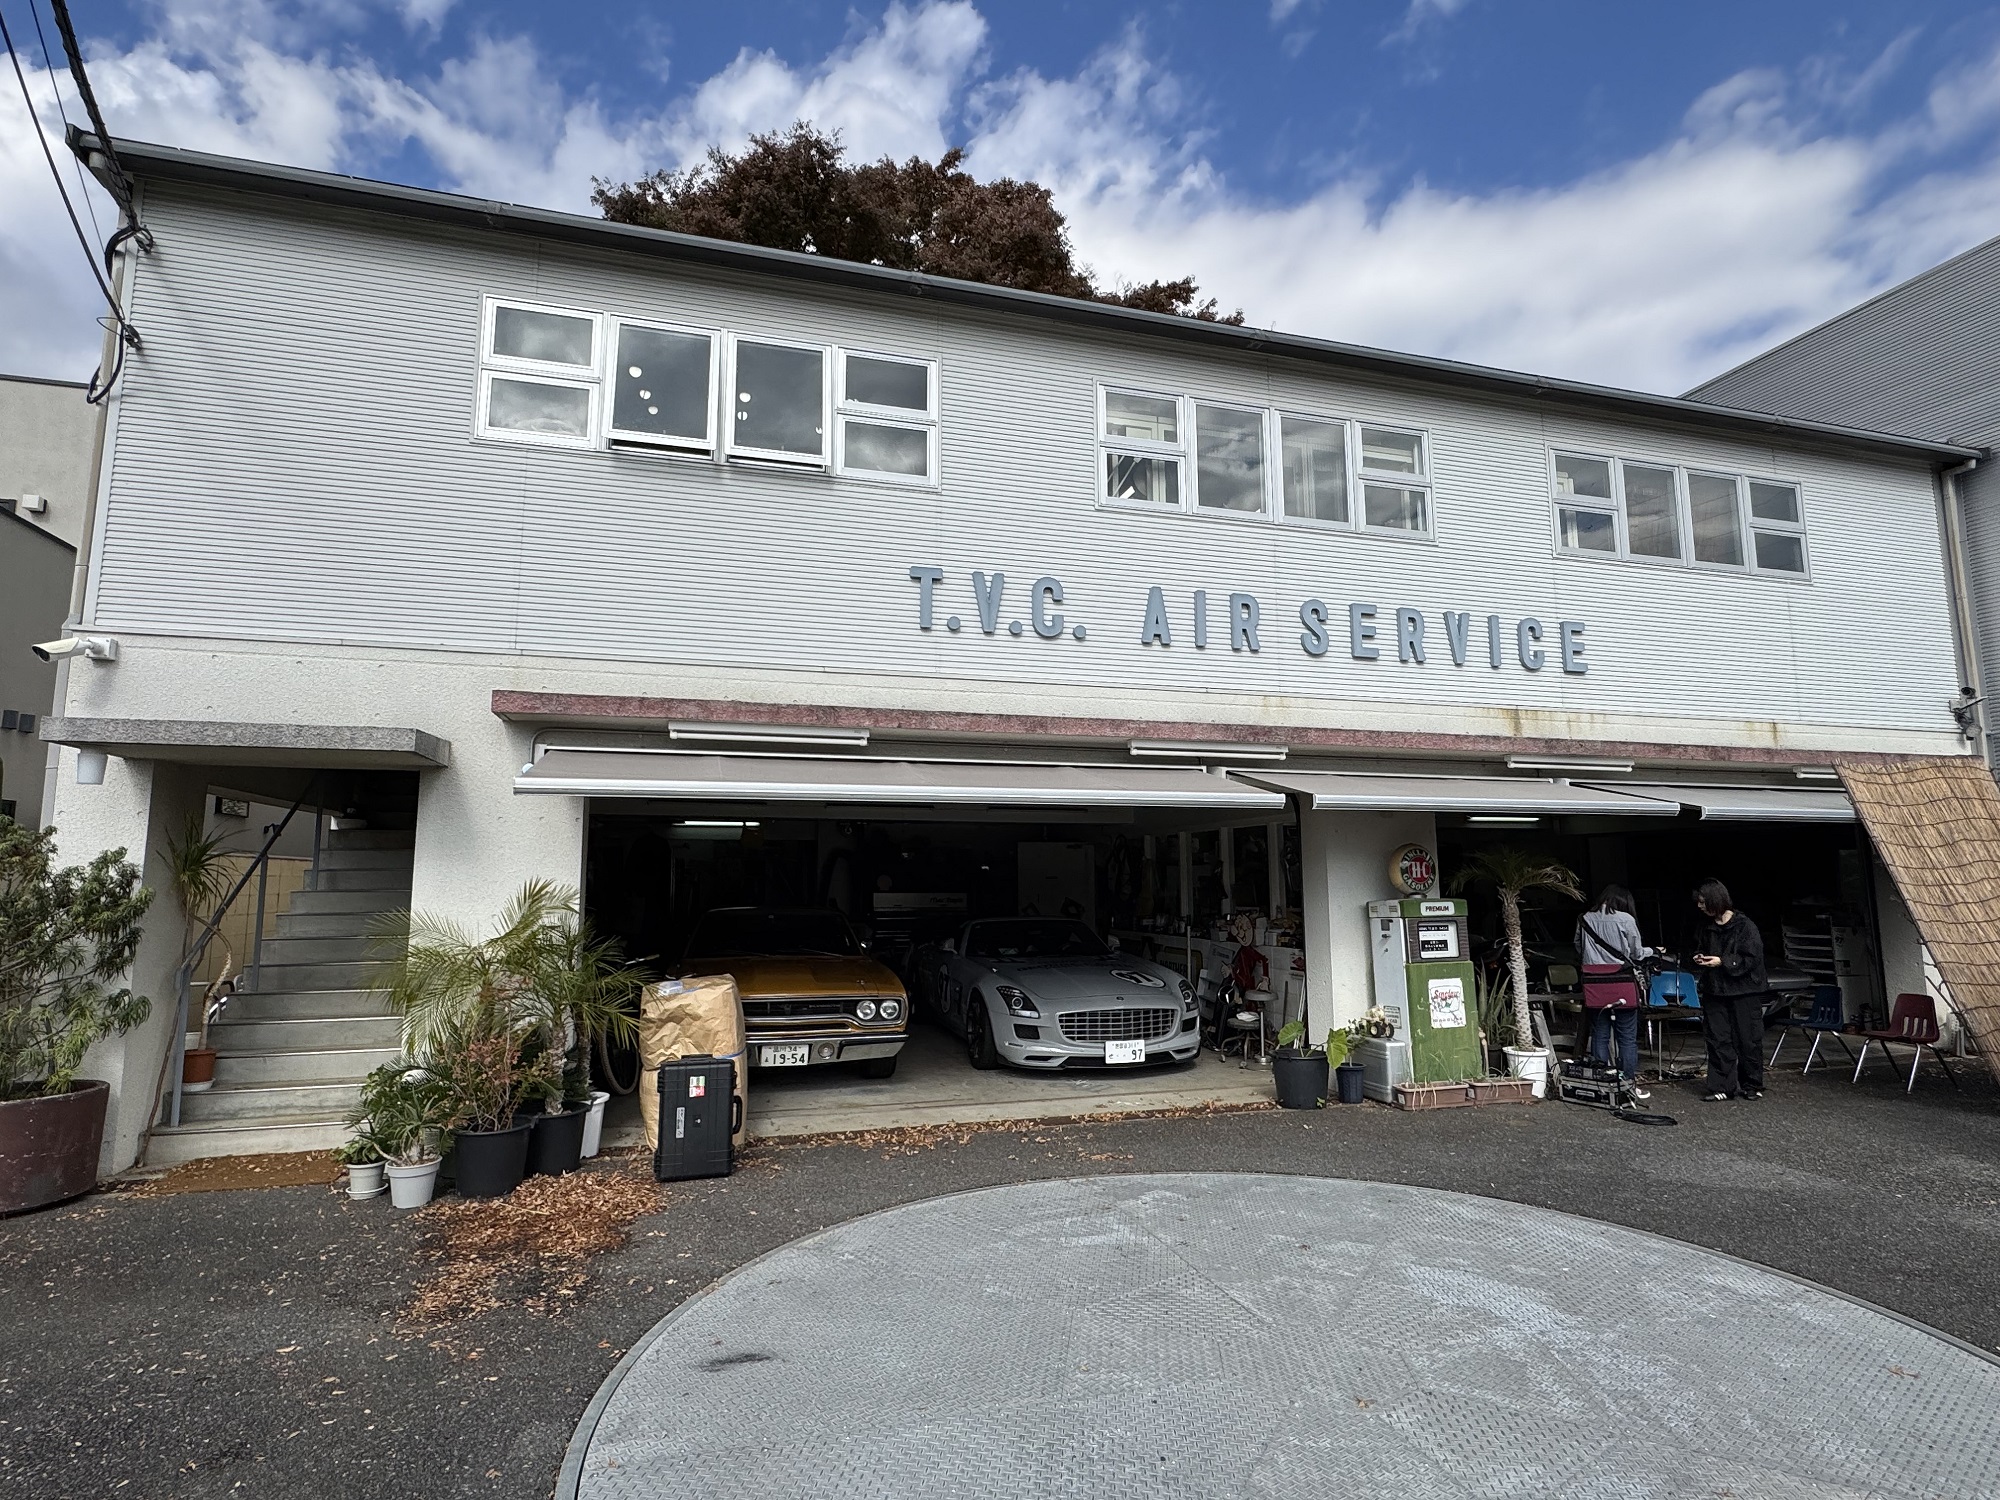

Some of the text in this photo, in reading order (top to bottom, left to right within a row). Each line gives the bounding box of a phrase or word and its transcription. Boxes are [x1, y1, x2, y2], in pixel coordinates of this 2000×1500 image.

[909, 566, 1589, 674] T.V.C. AIR SERVICE
[773, 1053, 805, 1064] 19-54
